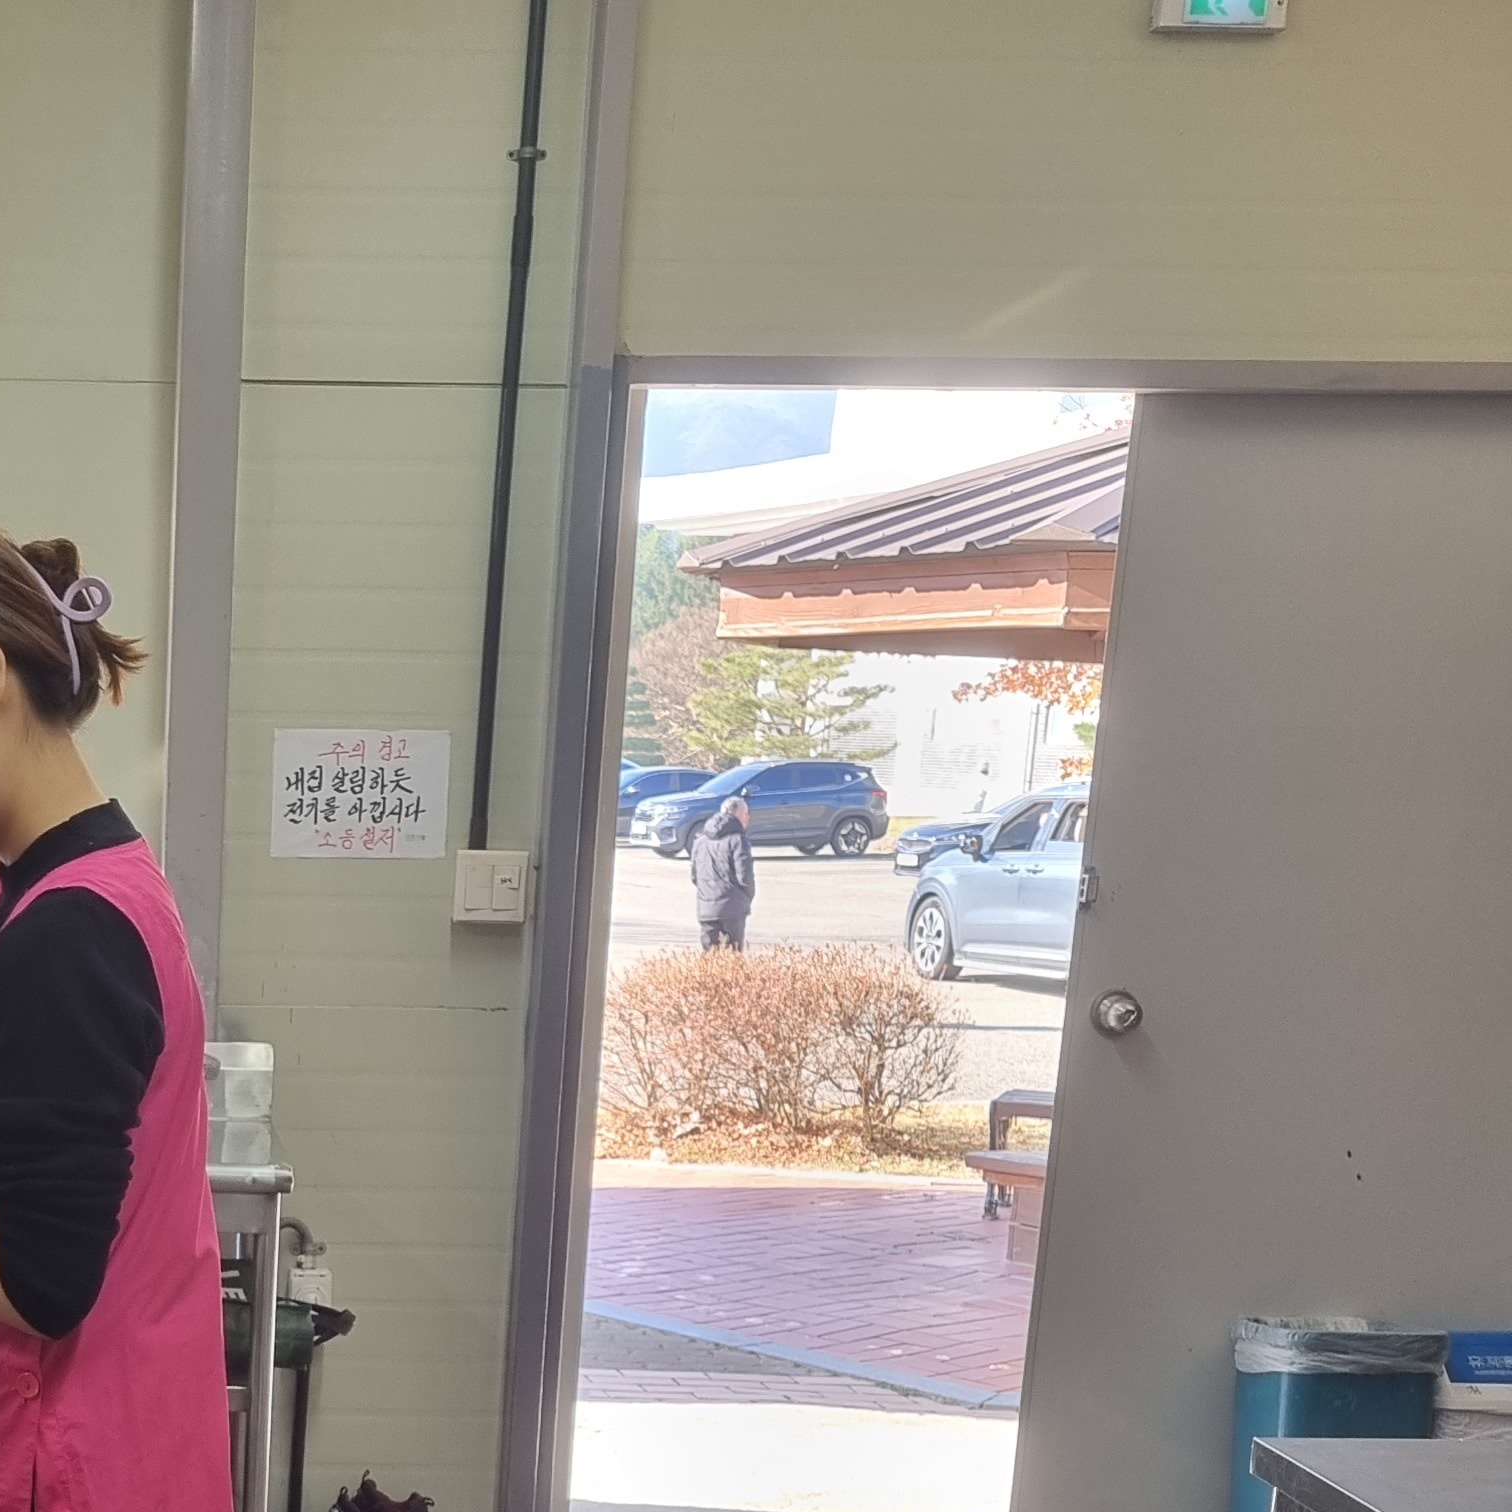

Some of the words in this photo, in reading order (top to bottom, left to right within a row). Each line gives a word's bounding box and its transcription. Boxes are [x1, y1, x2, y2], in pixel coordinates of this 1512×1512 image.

[318, 739, 365, 765] 주의
[378, 735, 410, 761] 경고
[285, 765, 323, 796] 내집
[284, 797, 340, 825] 전기를
